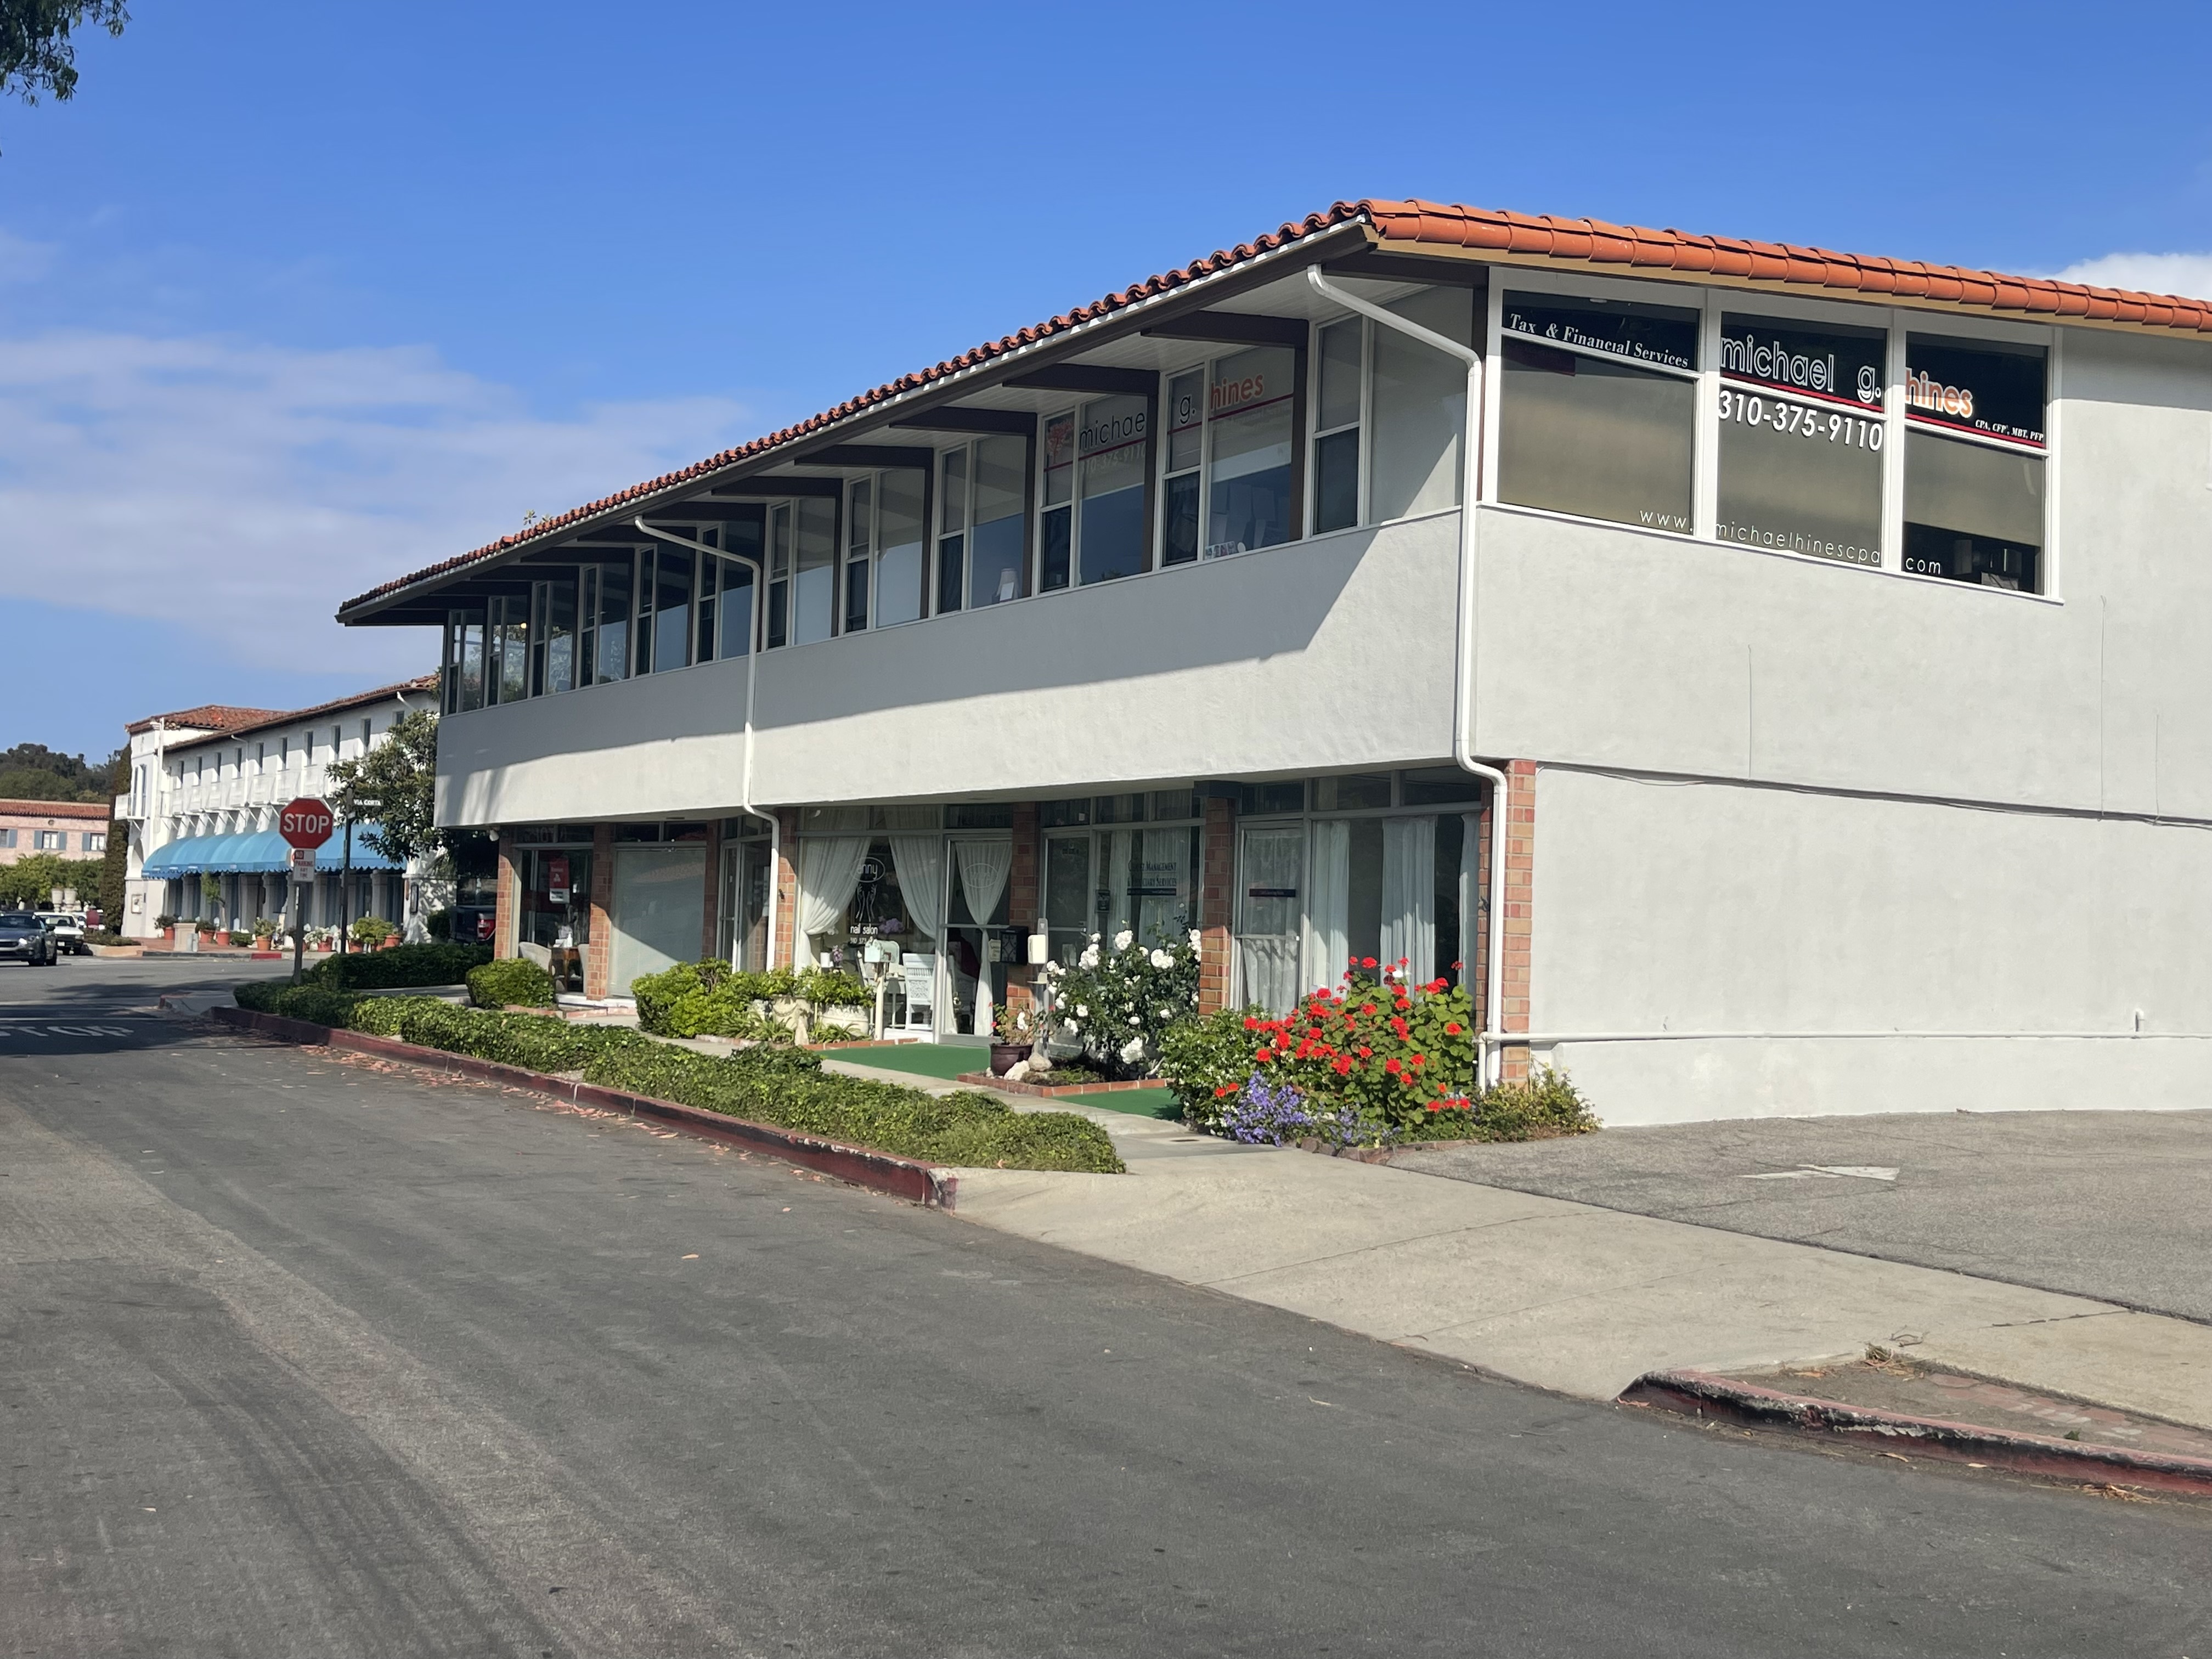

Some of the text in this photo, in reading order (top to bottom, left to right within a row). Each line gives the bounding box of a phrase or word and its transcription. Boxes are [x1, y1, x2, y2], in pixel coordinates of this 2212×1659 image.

[1510, 313, 1689, 368] Tax & Financial Services
[1720, 335, 1973, 419] michael g. hines
[1079, 412, 1146, 451] michae
[1209, 374, 1264, 411] hines
[1718, 390, 1883, 451] 310-375-9110
[283, 813, 330, 834] STOP
[850, 923, 878, 934] nail salon
